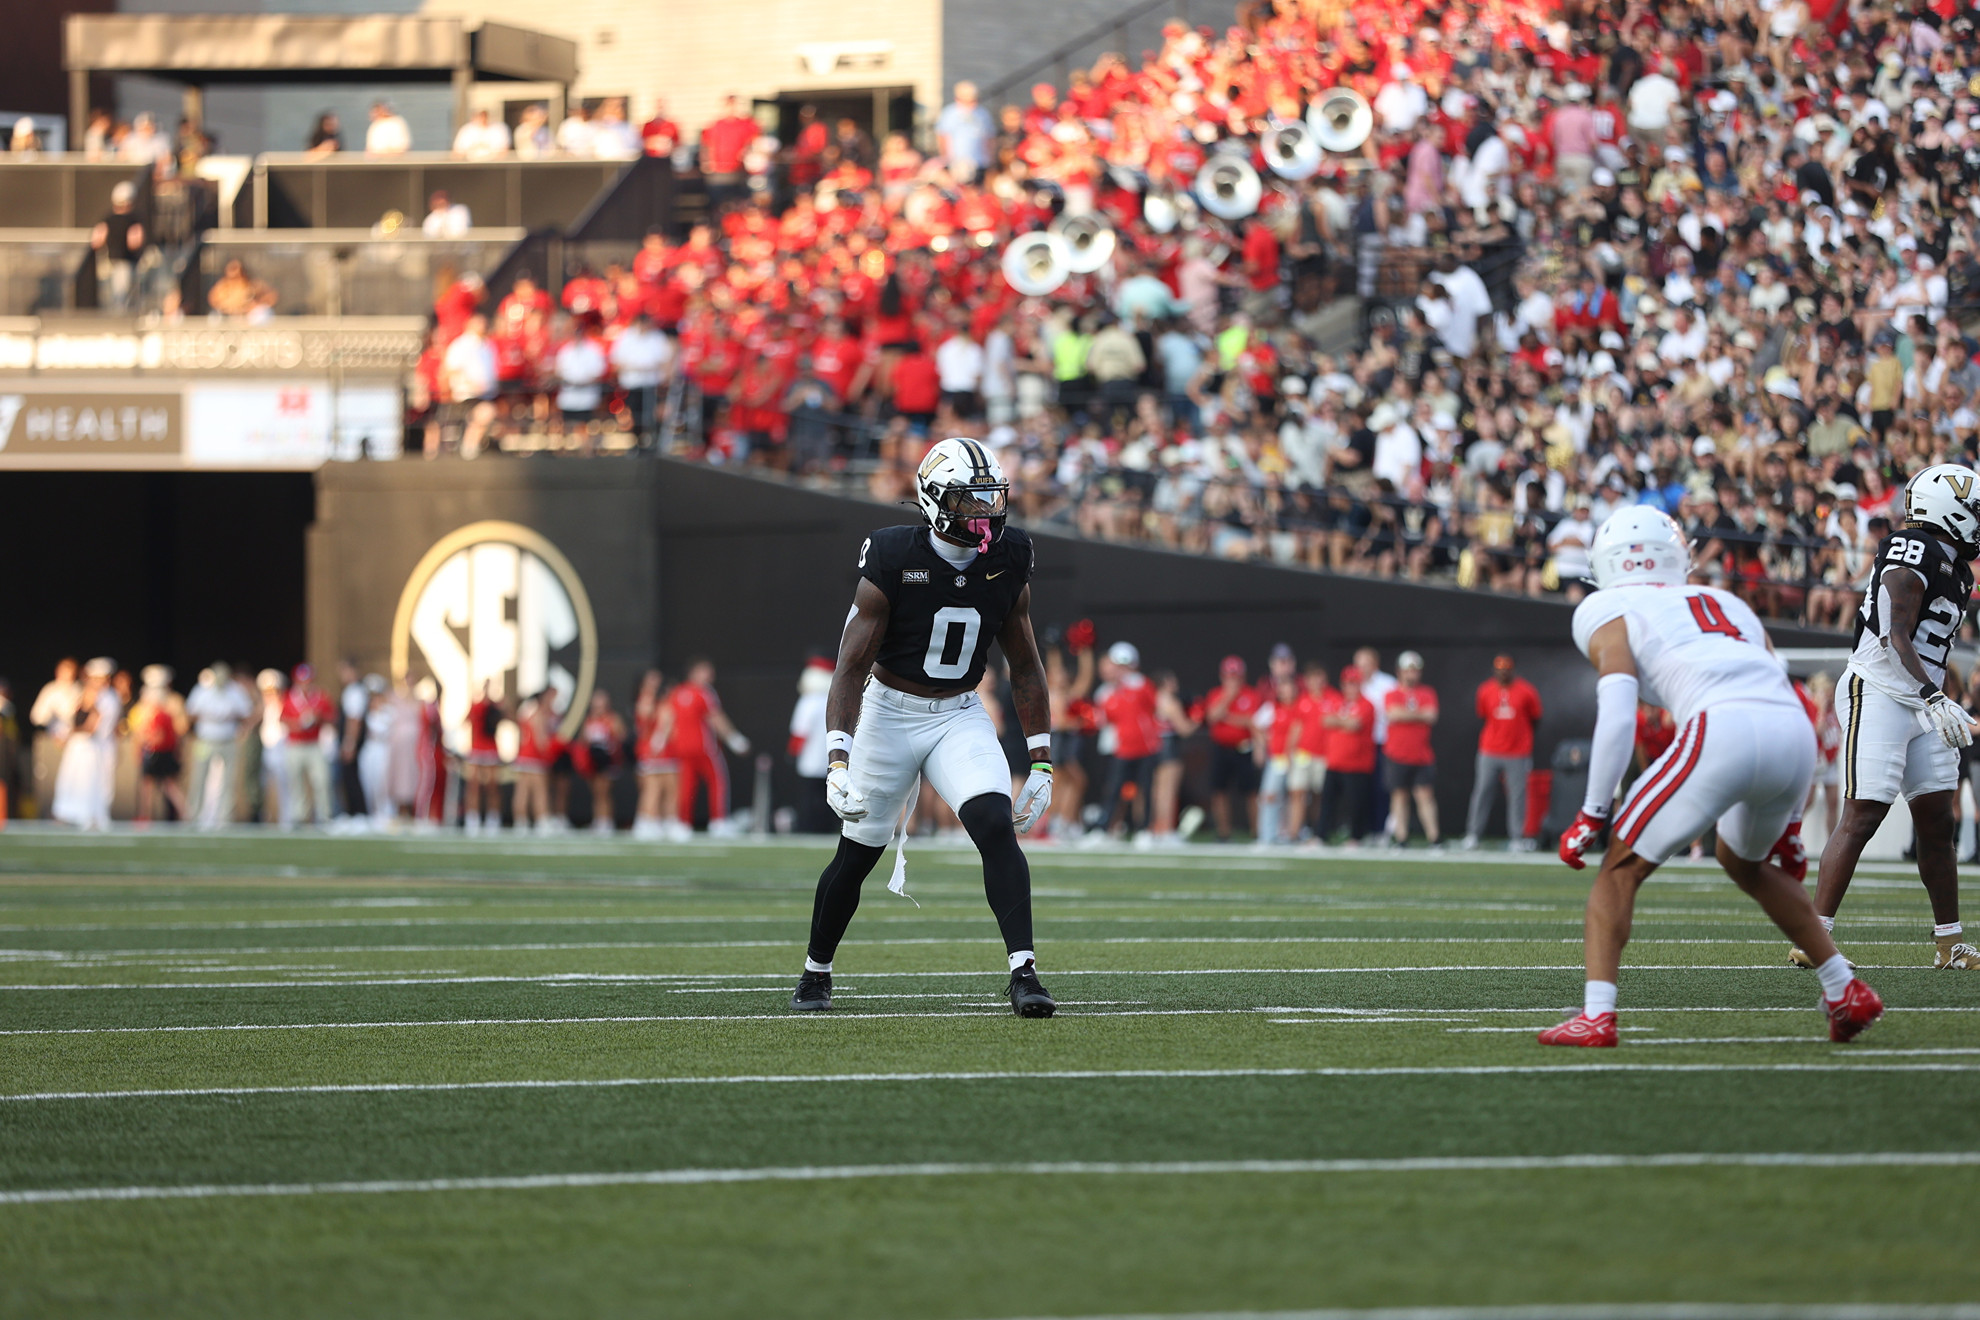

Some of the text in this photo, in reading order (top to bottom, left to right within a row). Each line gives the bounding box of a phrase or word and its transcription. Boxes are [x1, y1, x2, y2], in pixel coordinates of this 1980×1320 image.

[26, 406, 168, 441] HEALTH
[920, 449, 949, 480] V
[1942, 475, 1974, 499] V
[1885, 536, 1926, 565] 28
[908, 571, 928, 579] SRM
[1686, 592, 1749, 643] 4
[409, 541, 579, 762] SEC
[923, 606, 981, 680] 0
